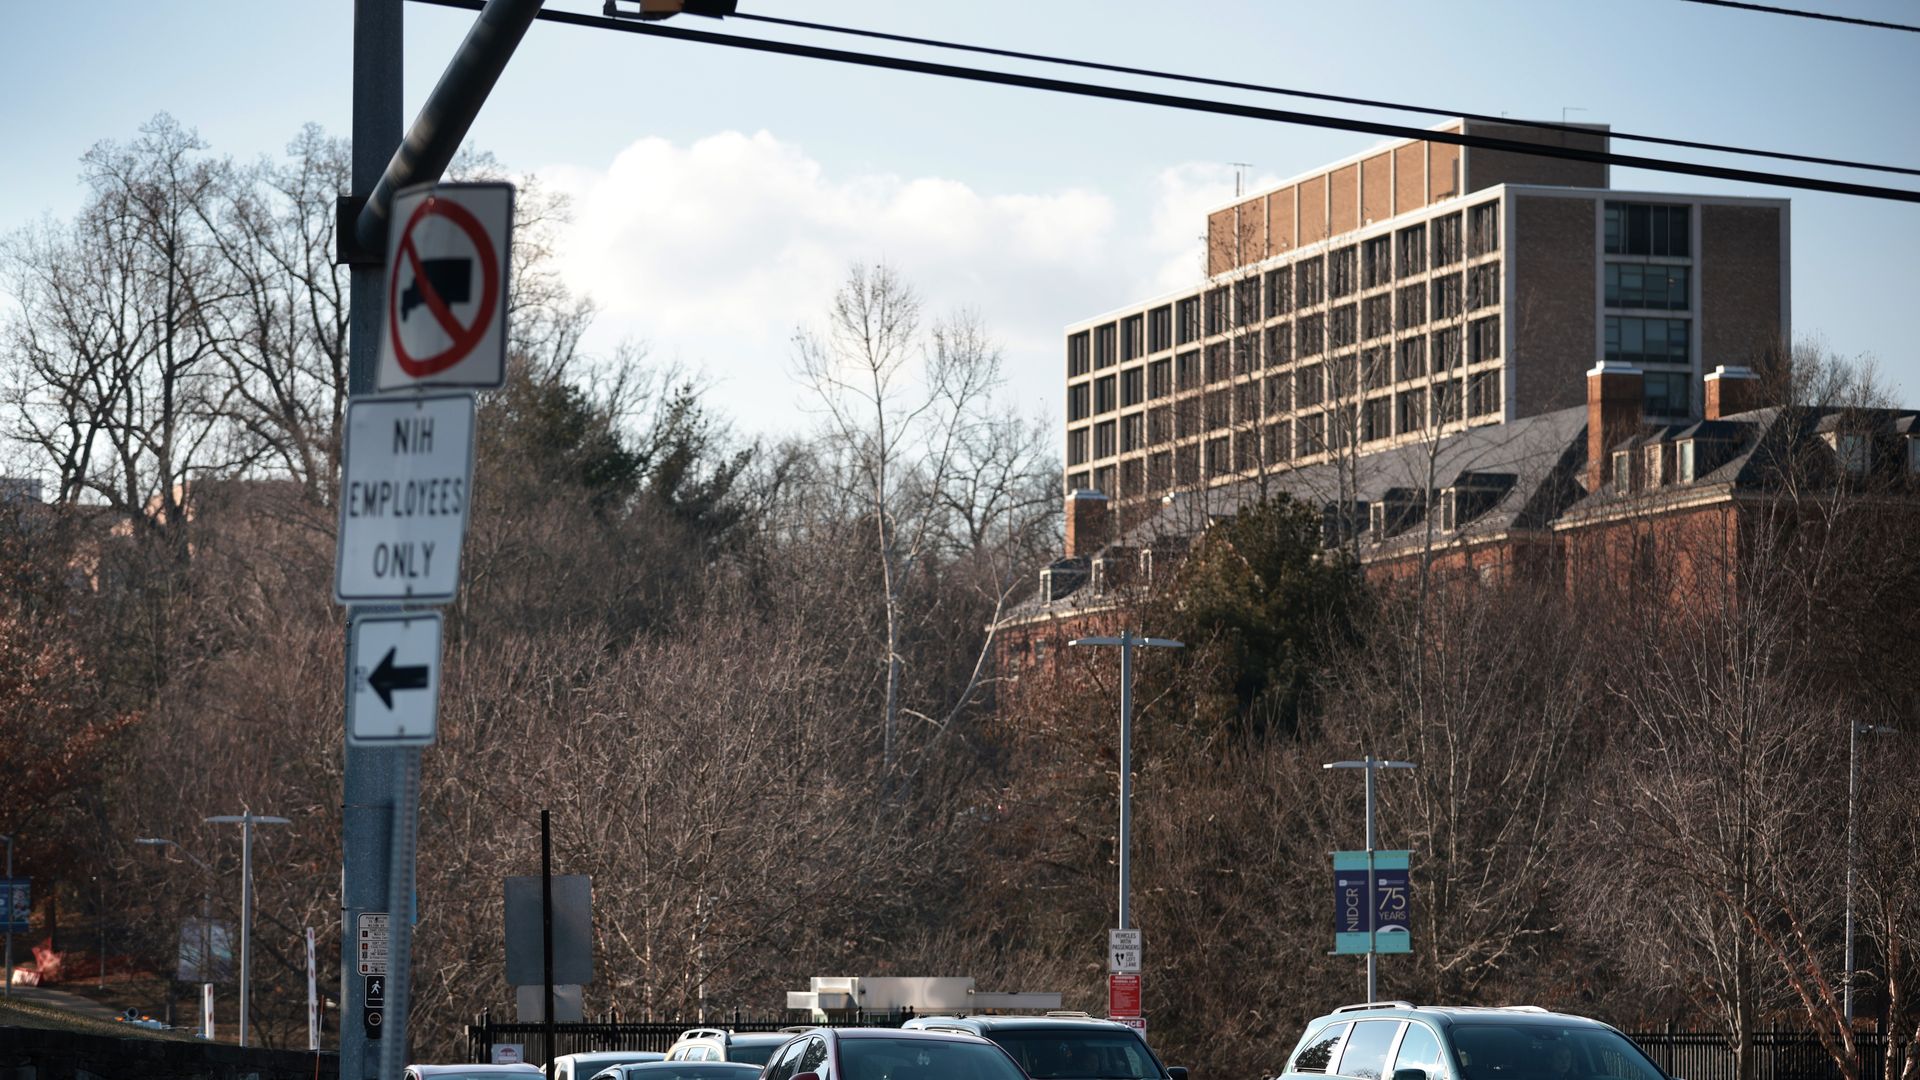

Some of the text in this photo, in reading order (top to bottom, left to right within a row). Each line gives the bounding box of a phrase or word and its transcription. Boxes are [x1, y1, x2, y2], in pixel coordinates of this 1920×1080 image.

[393, 417, 434, 455] NIH
[349, 477, 464, 518] EMPLOYEES
[373, 541, 436, 579] ONLY
[1345, 887, 1359, 932] NIDCR
[1378, 887, 1406, 910] 75
[1378, 911, 1407, 921] YEARS
